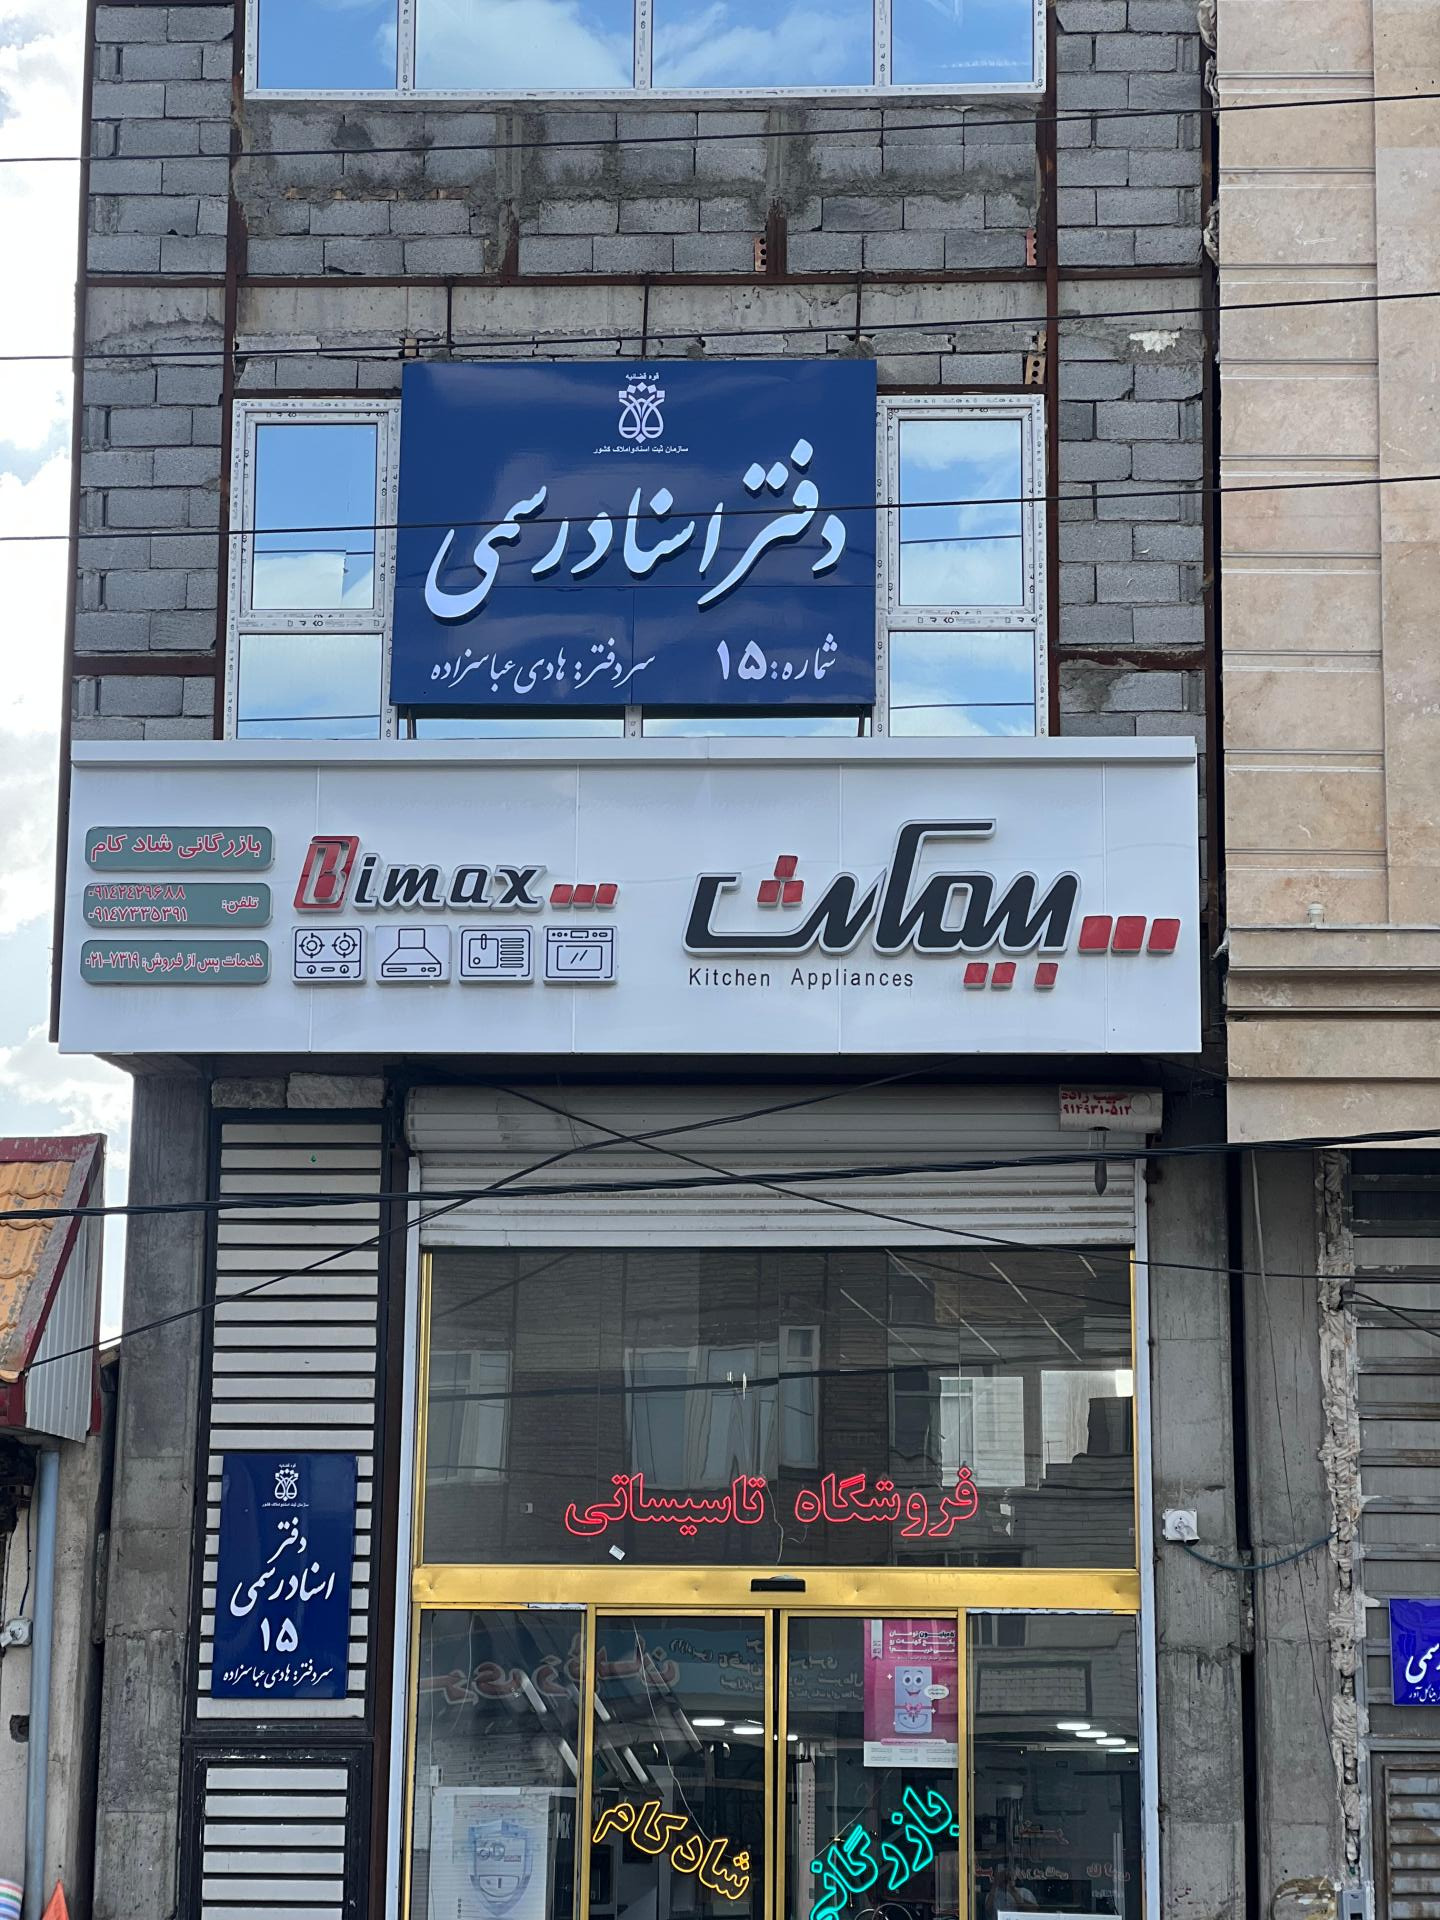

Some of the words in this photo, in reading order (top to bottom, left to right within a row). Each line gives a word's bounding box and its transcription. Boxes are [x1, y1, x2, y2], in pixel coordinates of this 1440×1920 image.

[592, 445, 611, 454] کشور
[651, 444, 664, 453] ثبت
[664, 445, 689, 454] سازمان
[570, 486, 724, 576] اسناد
[697, 438, 847, 606] دفتر
[424, 485, 571, 620] رسمی
[513, 647, 566, 695] هادی
[716, 639, 767, 682] ۱۵
[90, 834, 129, 862] کام
[132, 833, 173, 852] شاد
[177, 833, 262, 858] بازرگانی
[293, 836, 548, 913] Bimax
[184, 952, 196, 971] از
[197, 958, 220, 974] پس
[221, 952, 264, 968] خدمات
[688, 967, 771, 987] Kitchen
[791, 967, 914, 991] Appliances
[564, 1471, 766, 1538] تاسیساتی
[794, 1466, 980, 1538] فروشگاه
[266, 1516, 307, 1564] دفتر
[230, 1565, 285, 1617] رسمی
[284, 1561, 336, 1601] اسناد
[260, 1617, 299, 1652] ۱۵
[263, 1662, 290, 1689] هادی
[1405, 1642, 1440, 1684] سمی
[592, 1800, 689, 1855] کام
[671, 1834, 751, 1900] شاد
